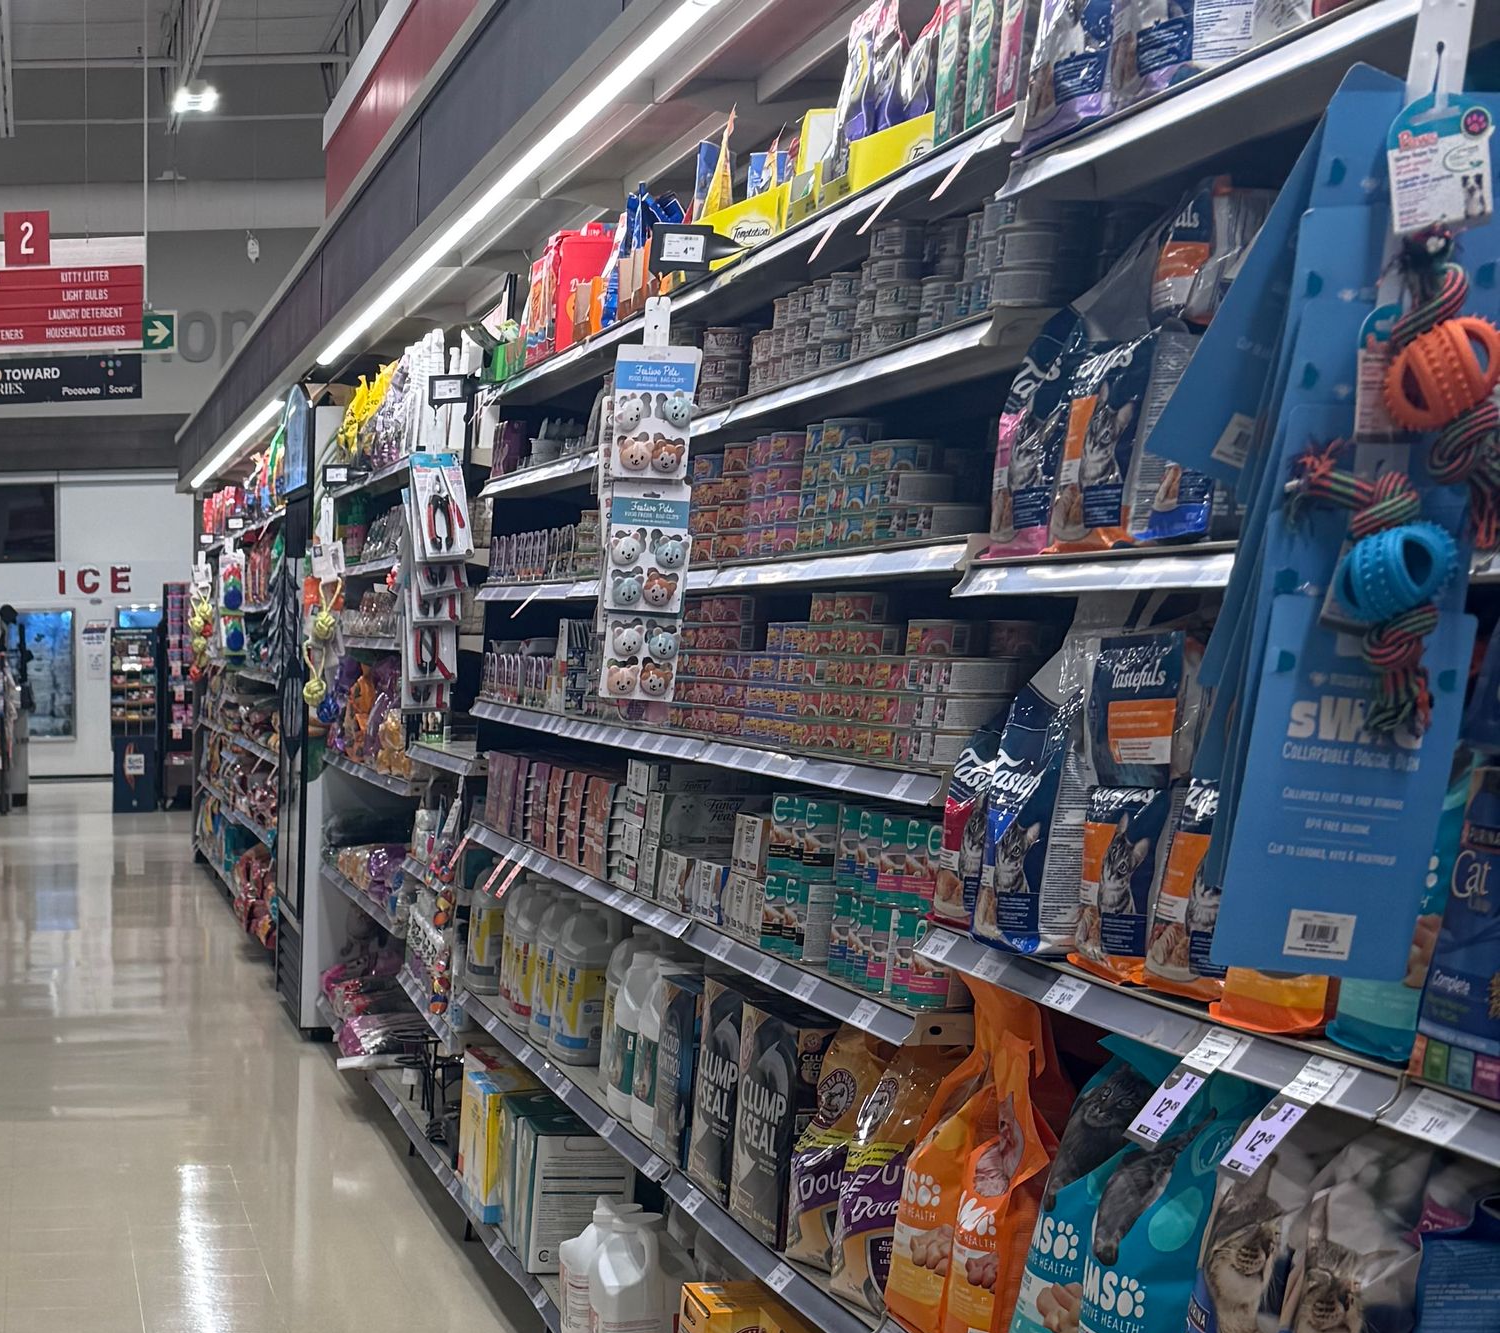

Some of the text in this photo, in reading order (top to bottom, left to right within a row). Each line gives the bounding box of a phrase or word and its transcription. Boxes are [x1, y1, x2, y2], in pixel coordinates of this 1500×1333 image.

[20, 222, 34, 254] 2
[60, 270, 109, 283] KITTY LITTER
[62, 289, 108, 301] LIGHT BULBS
[48, 307, 123, 320] LAUNDRY DETERGENT
[46, 325, 125, 339] HOUSEHOLD CLEANERS
[4, 367, 60, 381] TOWARD
[58, 565, 131, 595] ICE
[1112, 663, 1167, 693] Tastefuls
[1283, 740, 1349, 766] COLLAPSIBLE
[1353, 749, 1391, 768] DOGGIE
[1451, 849, 1492, 898] Cat
[741, 1072, 787, 1127] CLUMP
[1038, 1255, 1074, 1278] HEALTH
